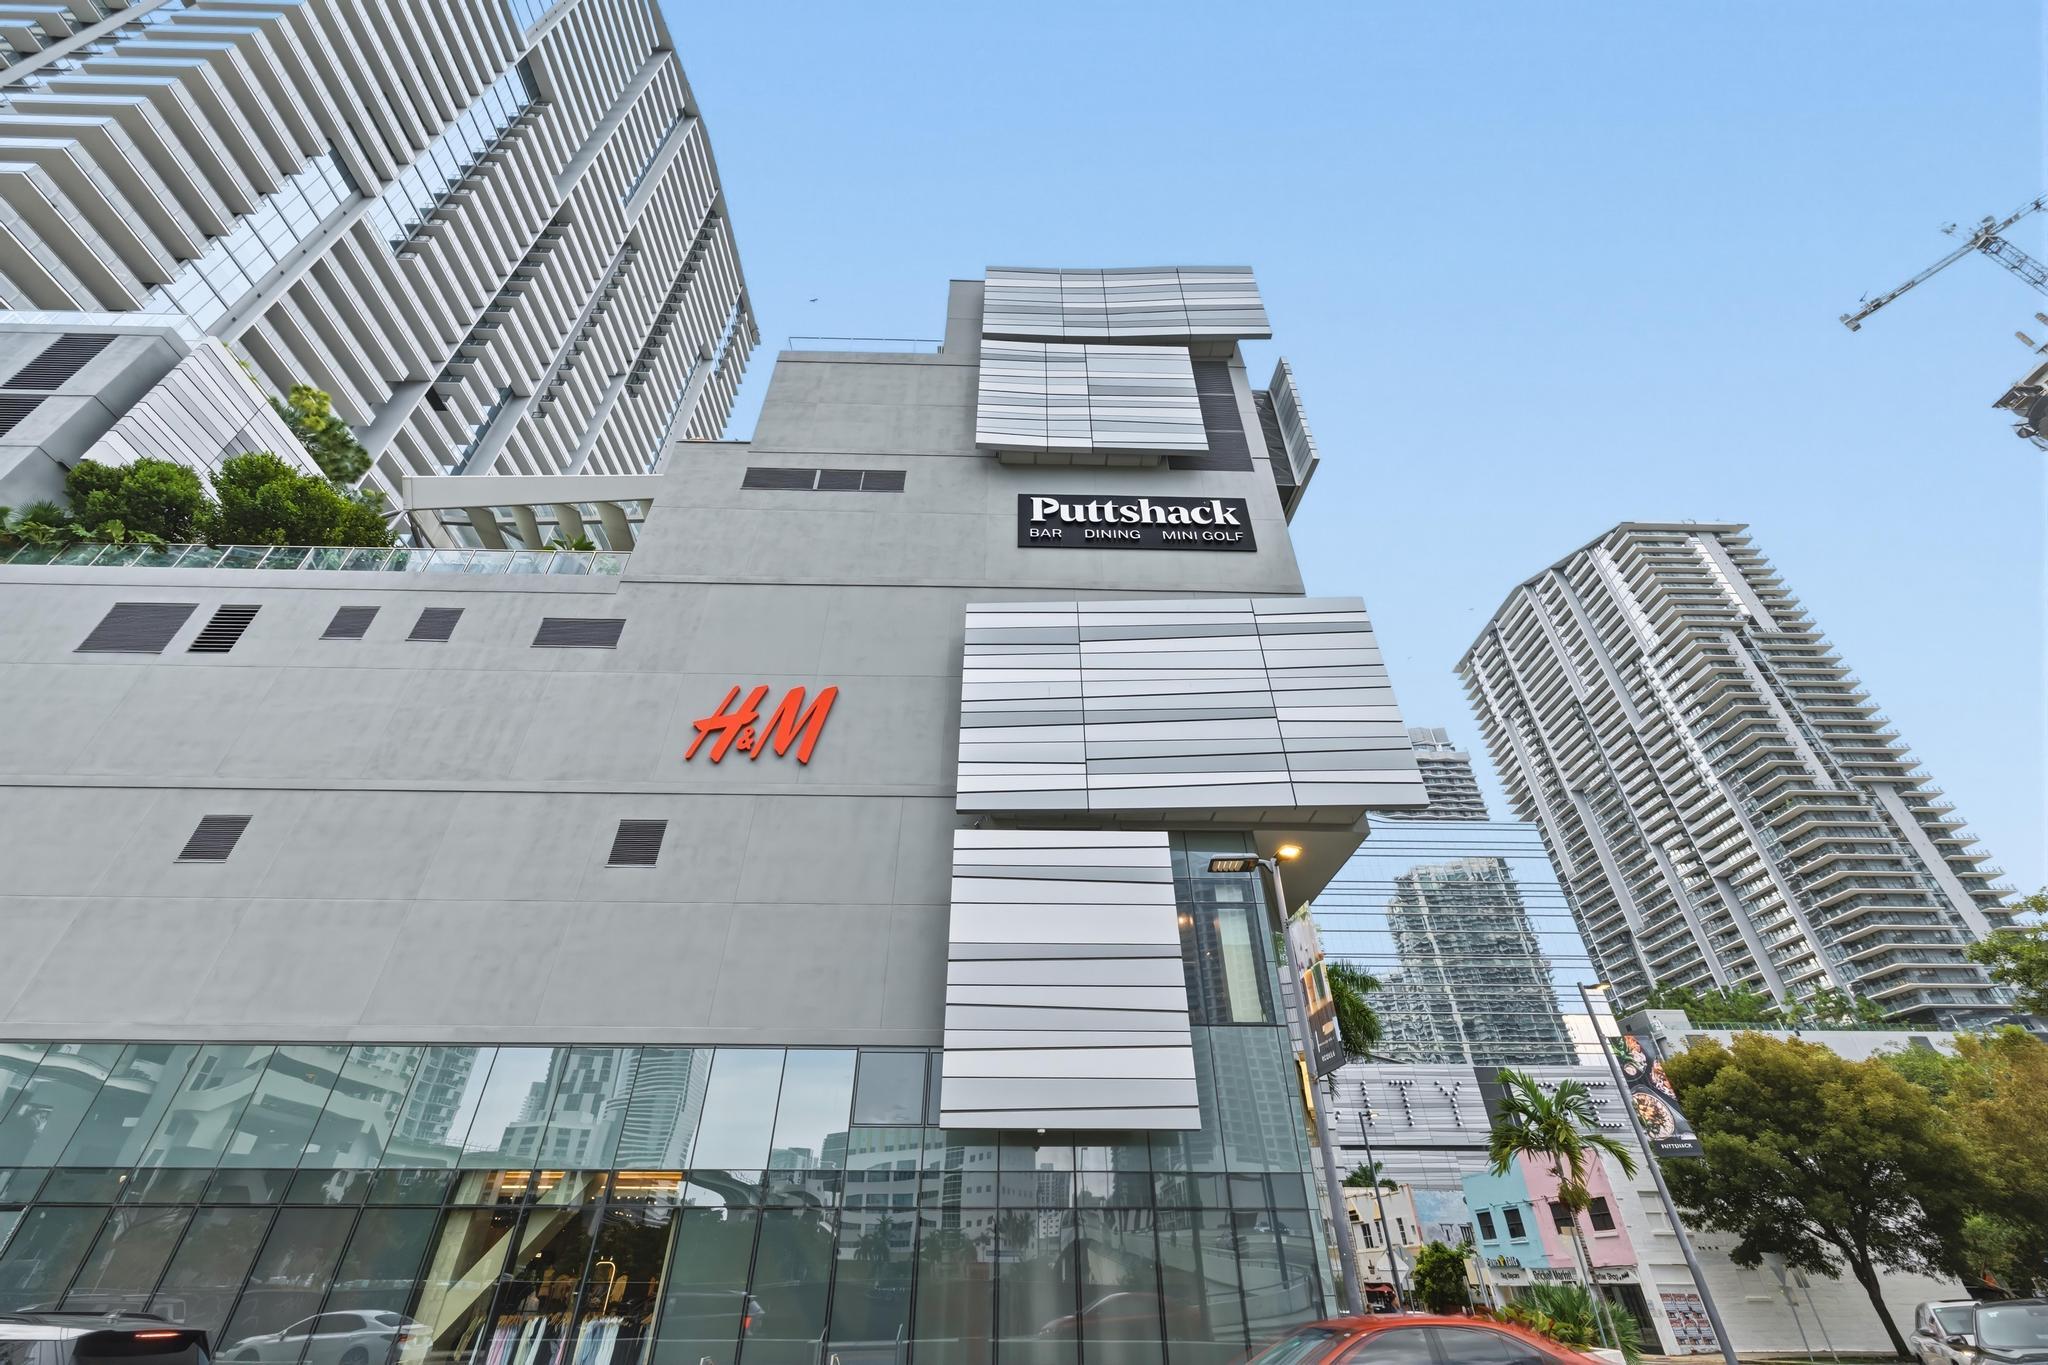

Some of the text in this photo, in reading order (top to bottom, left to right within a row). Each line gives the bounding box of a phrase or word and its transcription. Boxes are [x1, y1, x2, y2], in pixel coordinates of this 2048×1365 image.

[1030, 496, 1241, 526] Puttshack
[1029, 528, 1244, 543] BAR DINING MINI GOLF
[684, 684, 839, 765] H&M
[1335, 1080, 1463, 1127] ITY
